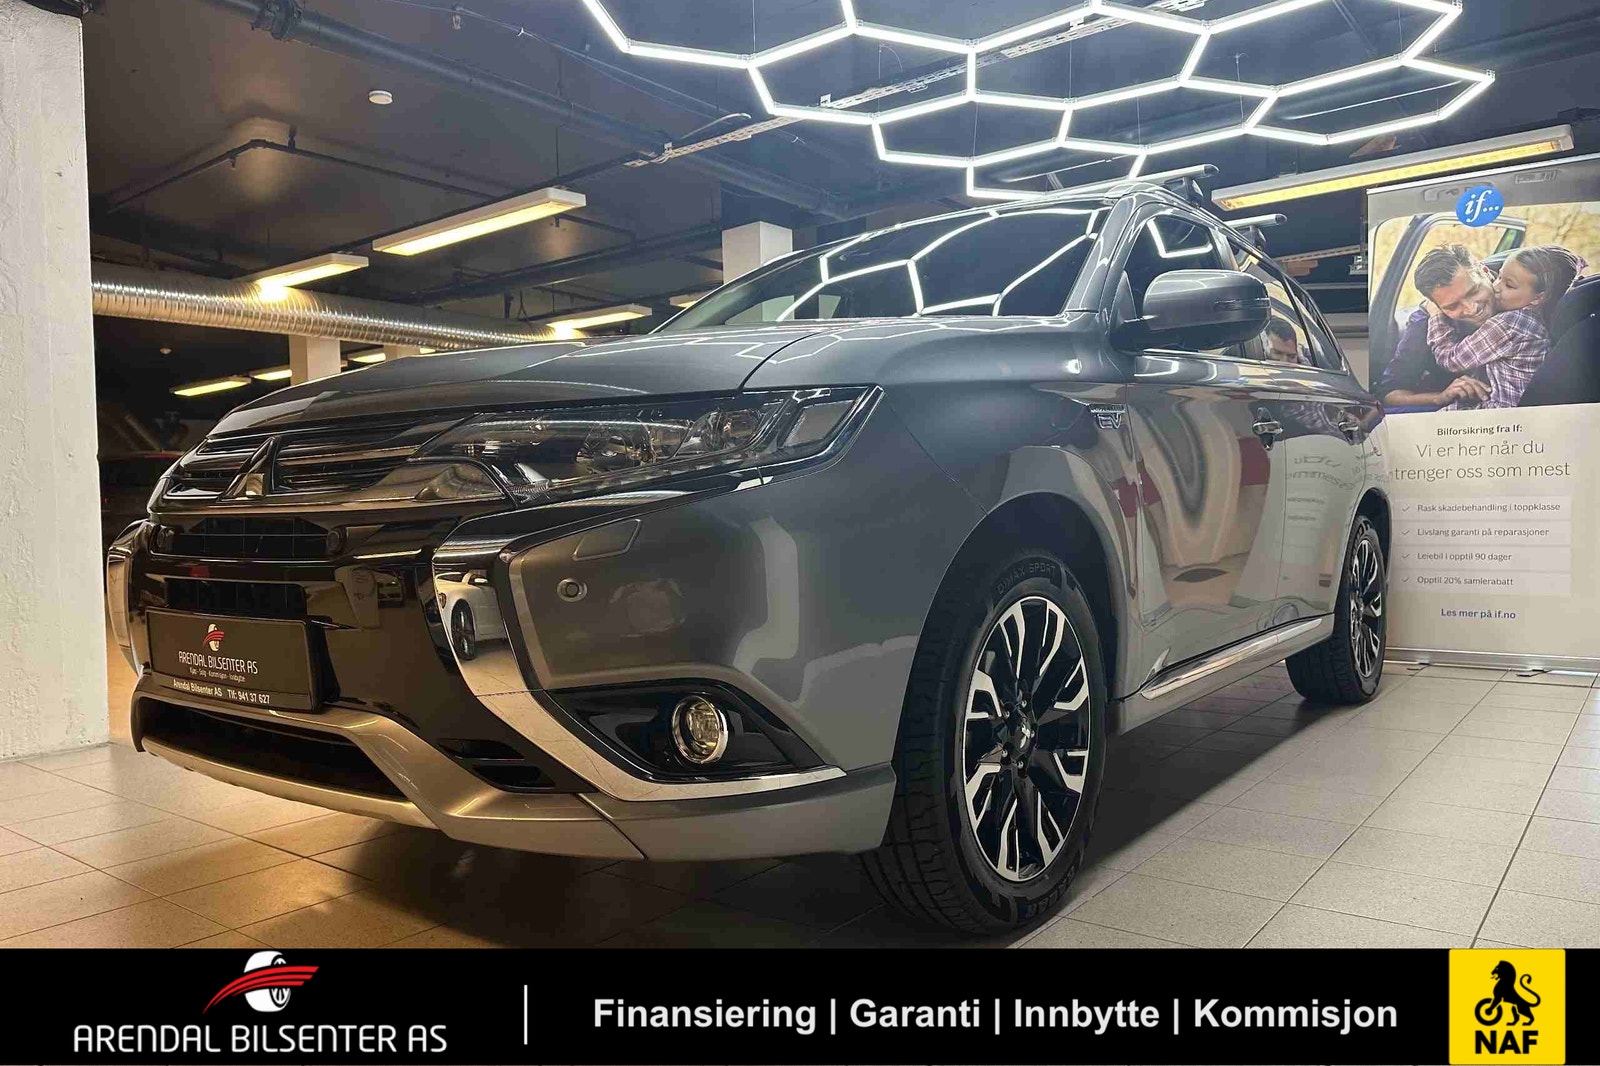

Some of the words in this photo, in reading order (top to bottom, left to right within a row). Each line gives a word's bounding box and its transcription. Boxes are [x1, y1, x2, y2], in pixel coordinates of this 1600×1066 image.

[1437, 426, 1495, 436] Bilforsikring
[1496, 425, 1511, 433] fra
[1416, 443, 1432, 458] Vi
[1436, 445, 1454, 457] er
[1458, 443, 1486, 456] her
[1490, 440, 1519, 455] når
[1522, 440, 1544, 454] du
[1394, 467, 1452, 482] trenger
[1456, 467, 1483, 478] oss
[1487, 465, 1522, 478] som
[1528, 462, 1571, 476] mest
[1417, 504, 1437, 512] Rask
[1438, 503, 1508, 512] skadebehandling
[1514, 503, 1561, 512] toppklasse
[1417, 529, 1449, 537] Livslang
[1451, 529, 1480, 537] garanti
[1482, 528, 1492, 537] på
[1494, 528, 1549, 537] reparasjoner
[1417, 552, 1444, 560] Leiebil
[1449, 553, 1474, 562] opptil
[1475, 553, 1486, 561] 90
[1488, 553, 1512, 562] dager
[1028, 562, 1056, 579] SPORT
[1417, 576, 1442, 585] Opptil
[1444, 576, 1462, 584] 20%
[1464, 577, 1514, 586] samlerabatt
[1441, 608, 1457, 617] Les
[1459, 609, 1478, 618] mer
[1480, 609, 1492, 619] på
[1494, 610, 1516, 619] if.no
[178, 651, 207, 668] ARENDAL
[208, 655, 245, 673] BILSENTER
[247, 660, 258, 675] AS
[173, 679, 190, 691] Arendal
[190, 682, 213, 696] Bilsenter
[214, 687, 223, 697] AS
[238, 691, 249, 702] 941
[249, 693, 257, 702] 37
[258, 694, 270, 705] 627
